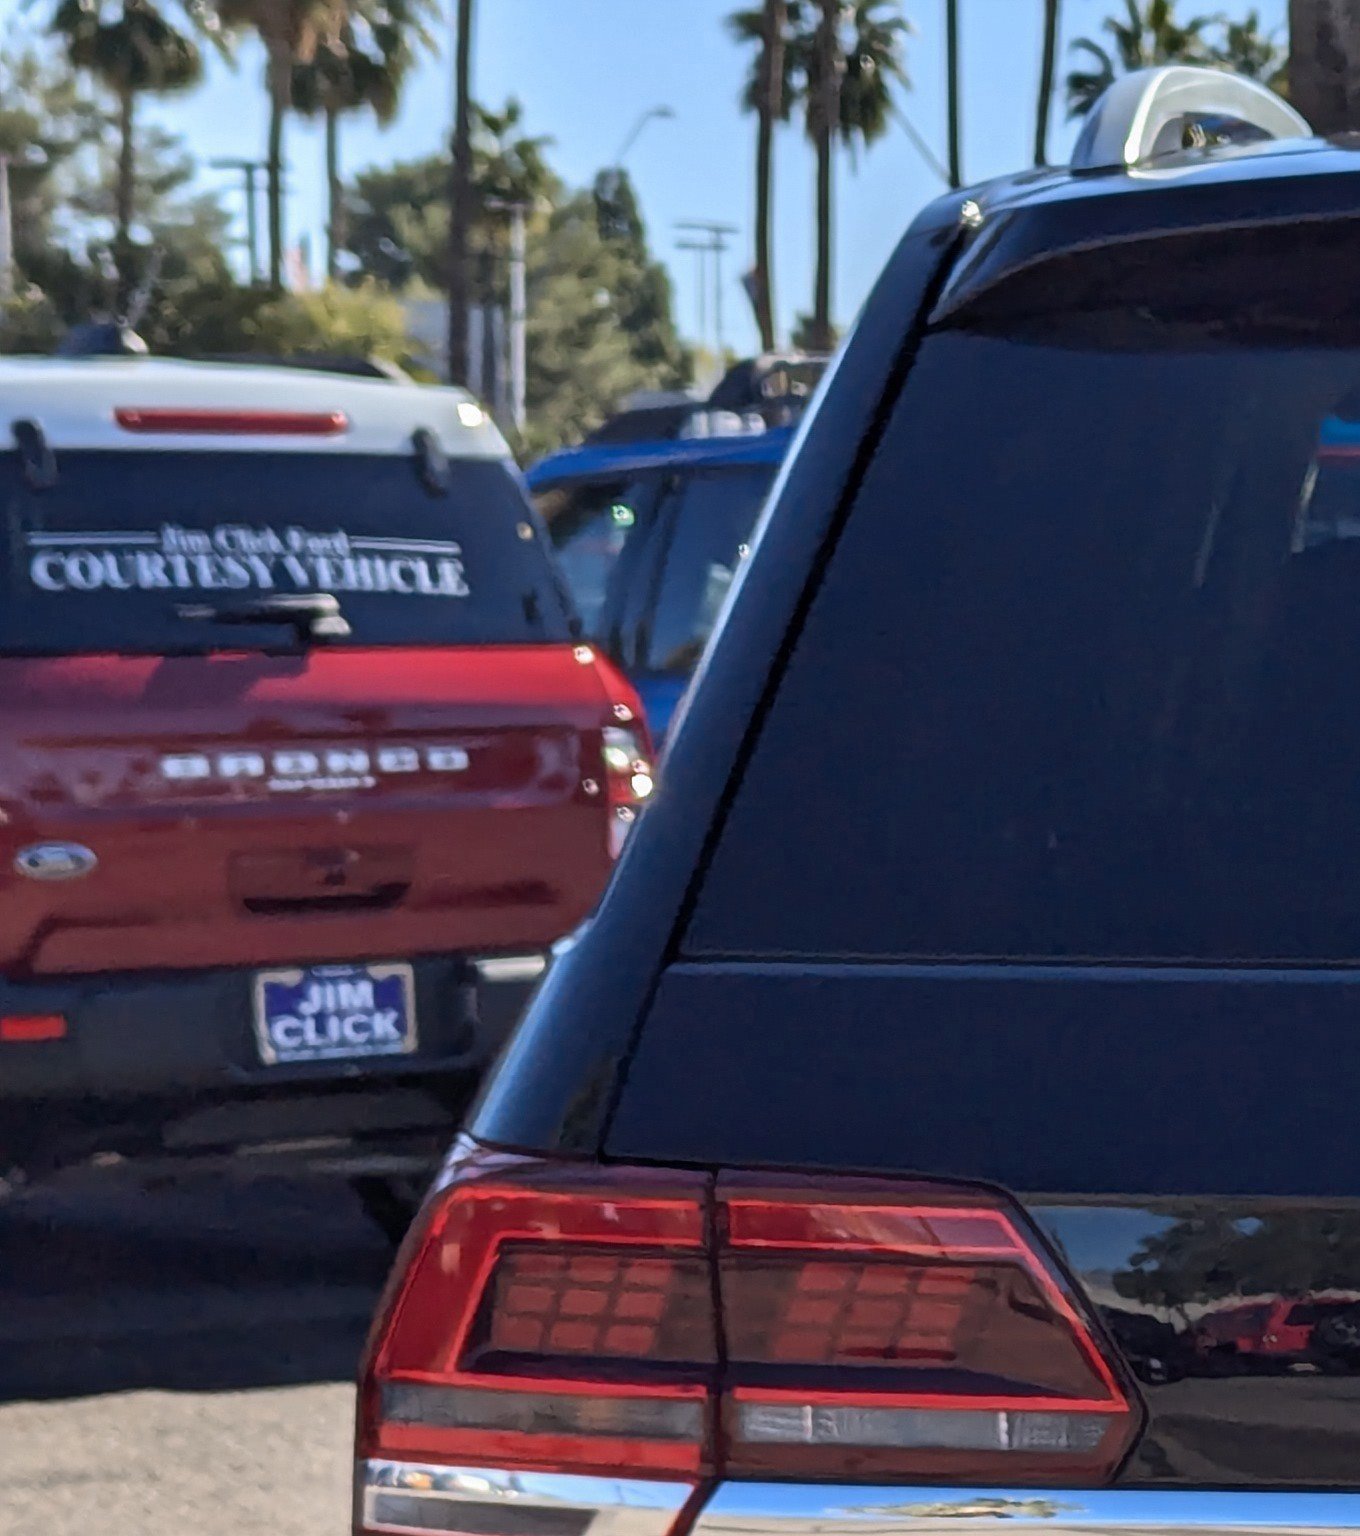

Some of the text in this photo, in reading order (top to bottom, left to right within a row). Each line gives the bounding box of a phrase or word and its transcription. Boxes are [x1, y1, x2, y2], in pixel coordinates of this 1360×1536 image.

[30, 550, 469, 596] COURTESY VEHICLE
[161, 747, 469, 778] BRONCO
[299, 979, 374, 1016] JIM
[271, 1008, 401, 1048] CLICK
